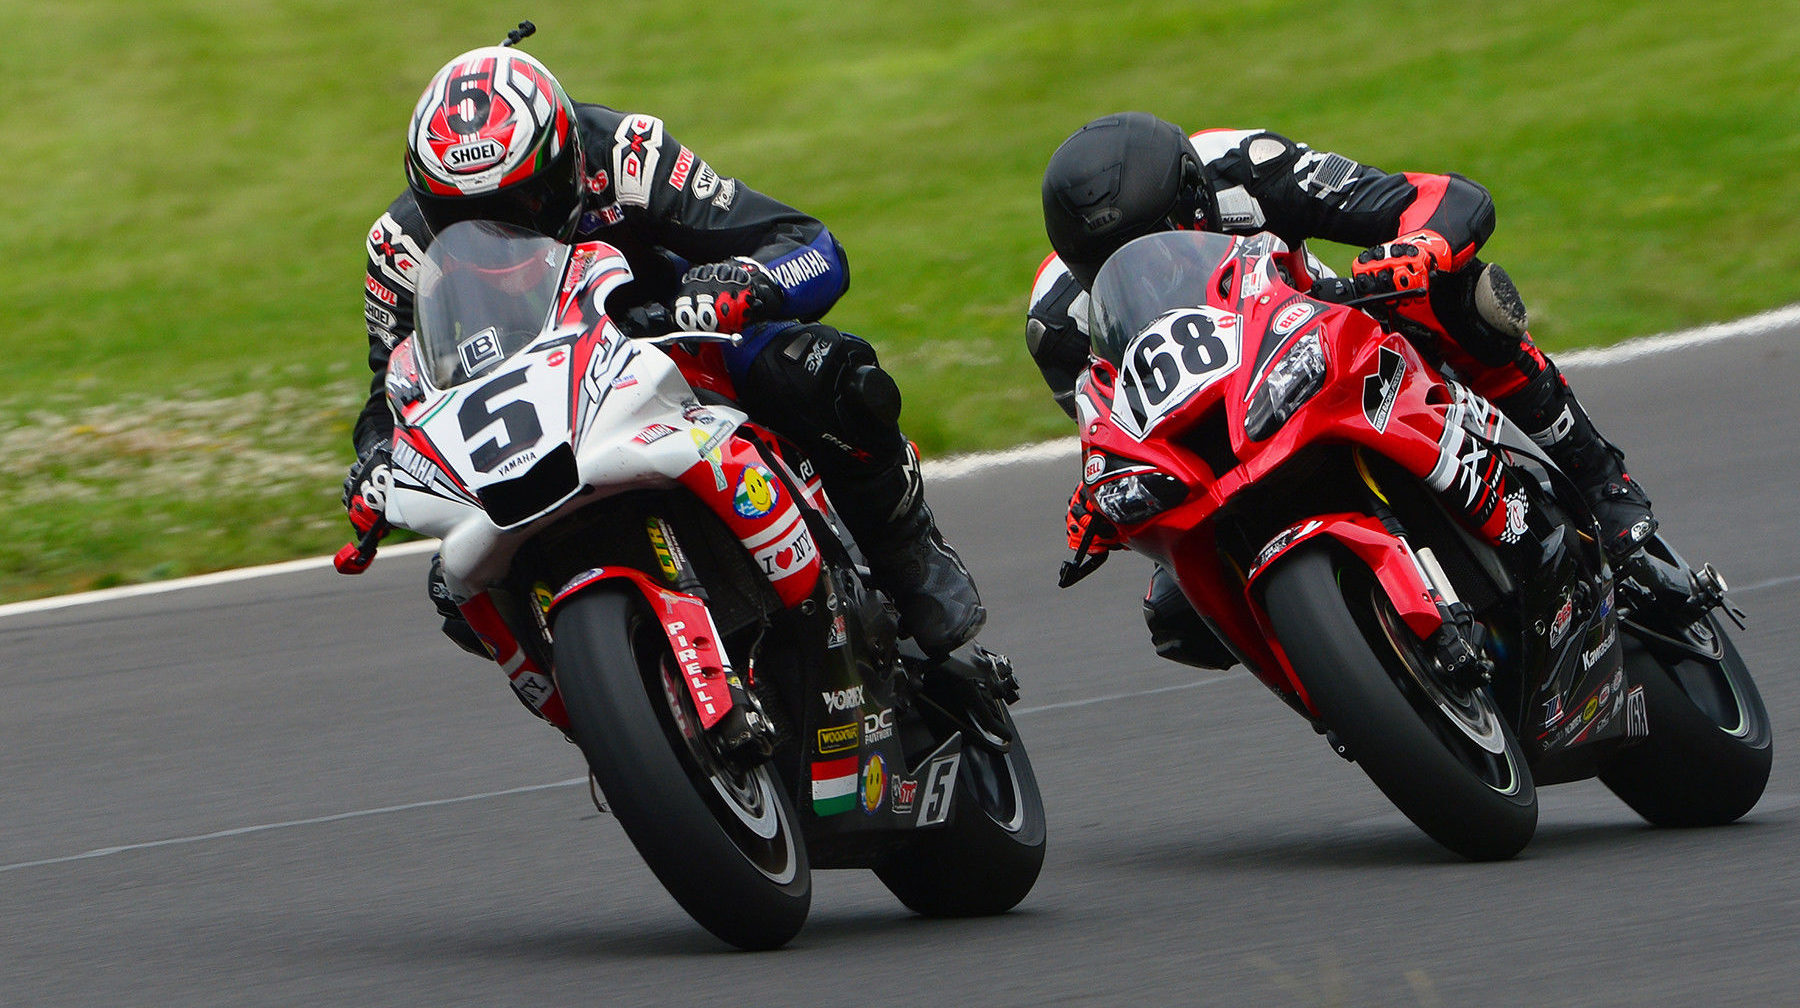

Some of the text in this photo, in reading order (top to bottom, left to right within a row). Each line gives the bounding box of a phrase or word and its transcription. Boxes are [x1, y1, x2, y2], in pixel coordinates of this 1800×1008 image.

[447, 72, 491, 135] 5
[451, 143, 496, 165] SHOEI
[670, 147, 694, 189] MOTU
[697, 164, 716, 191] SHO
[770, 249, 830, 289] YAMAHA
[1279, 307, 1310, 331] BELL
[1122, 313, 1229, 434] 168
[458, 363, 544, 473] 5
[639, 423, 675, 444] YAMAHA
[498, 451, 537, 477] YAMAHA
[1086, 461, 1102, 477] BELL
[763, 529, 813, 575] I NY
[667, 621, 716, 715] PIRELLI
[864, 708, 893, 735] DC
[926, 762, 953, 826] 5
